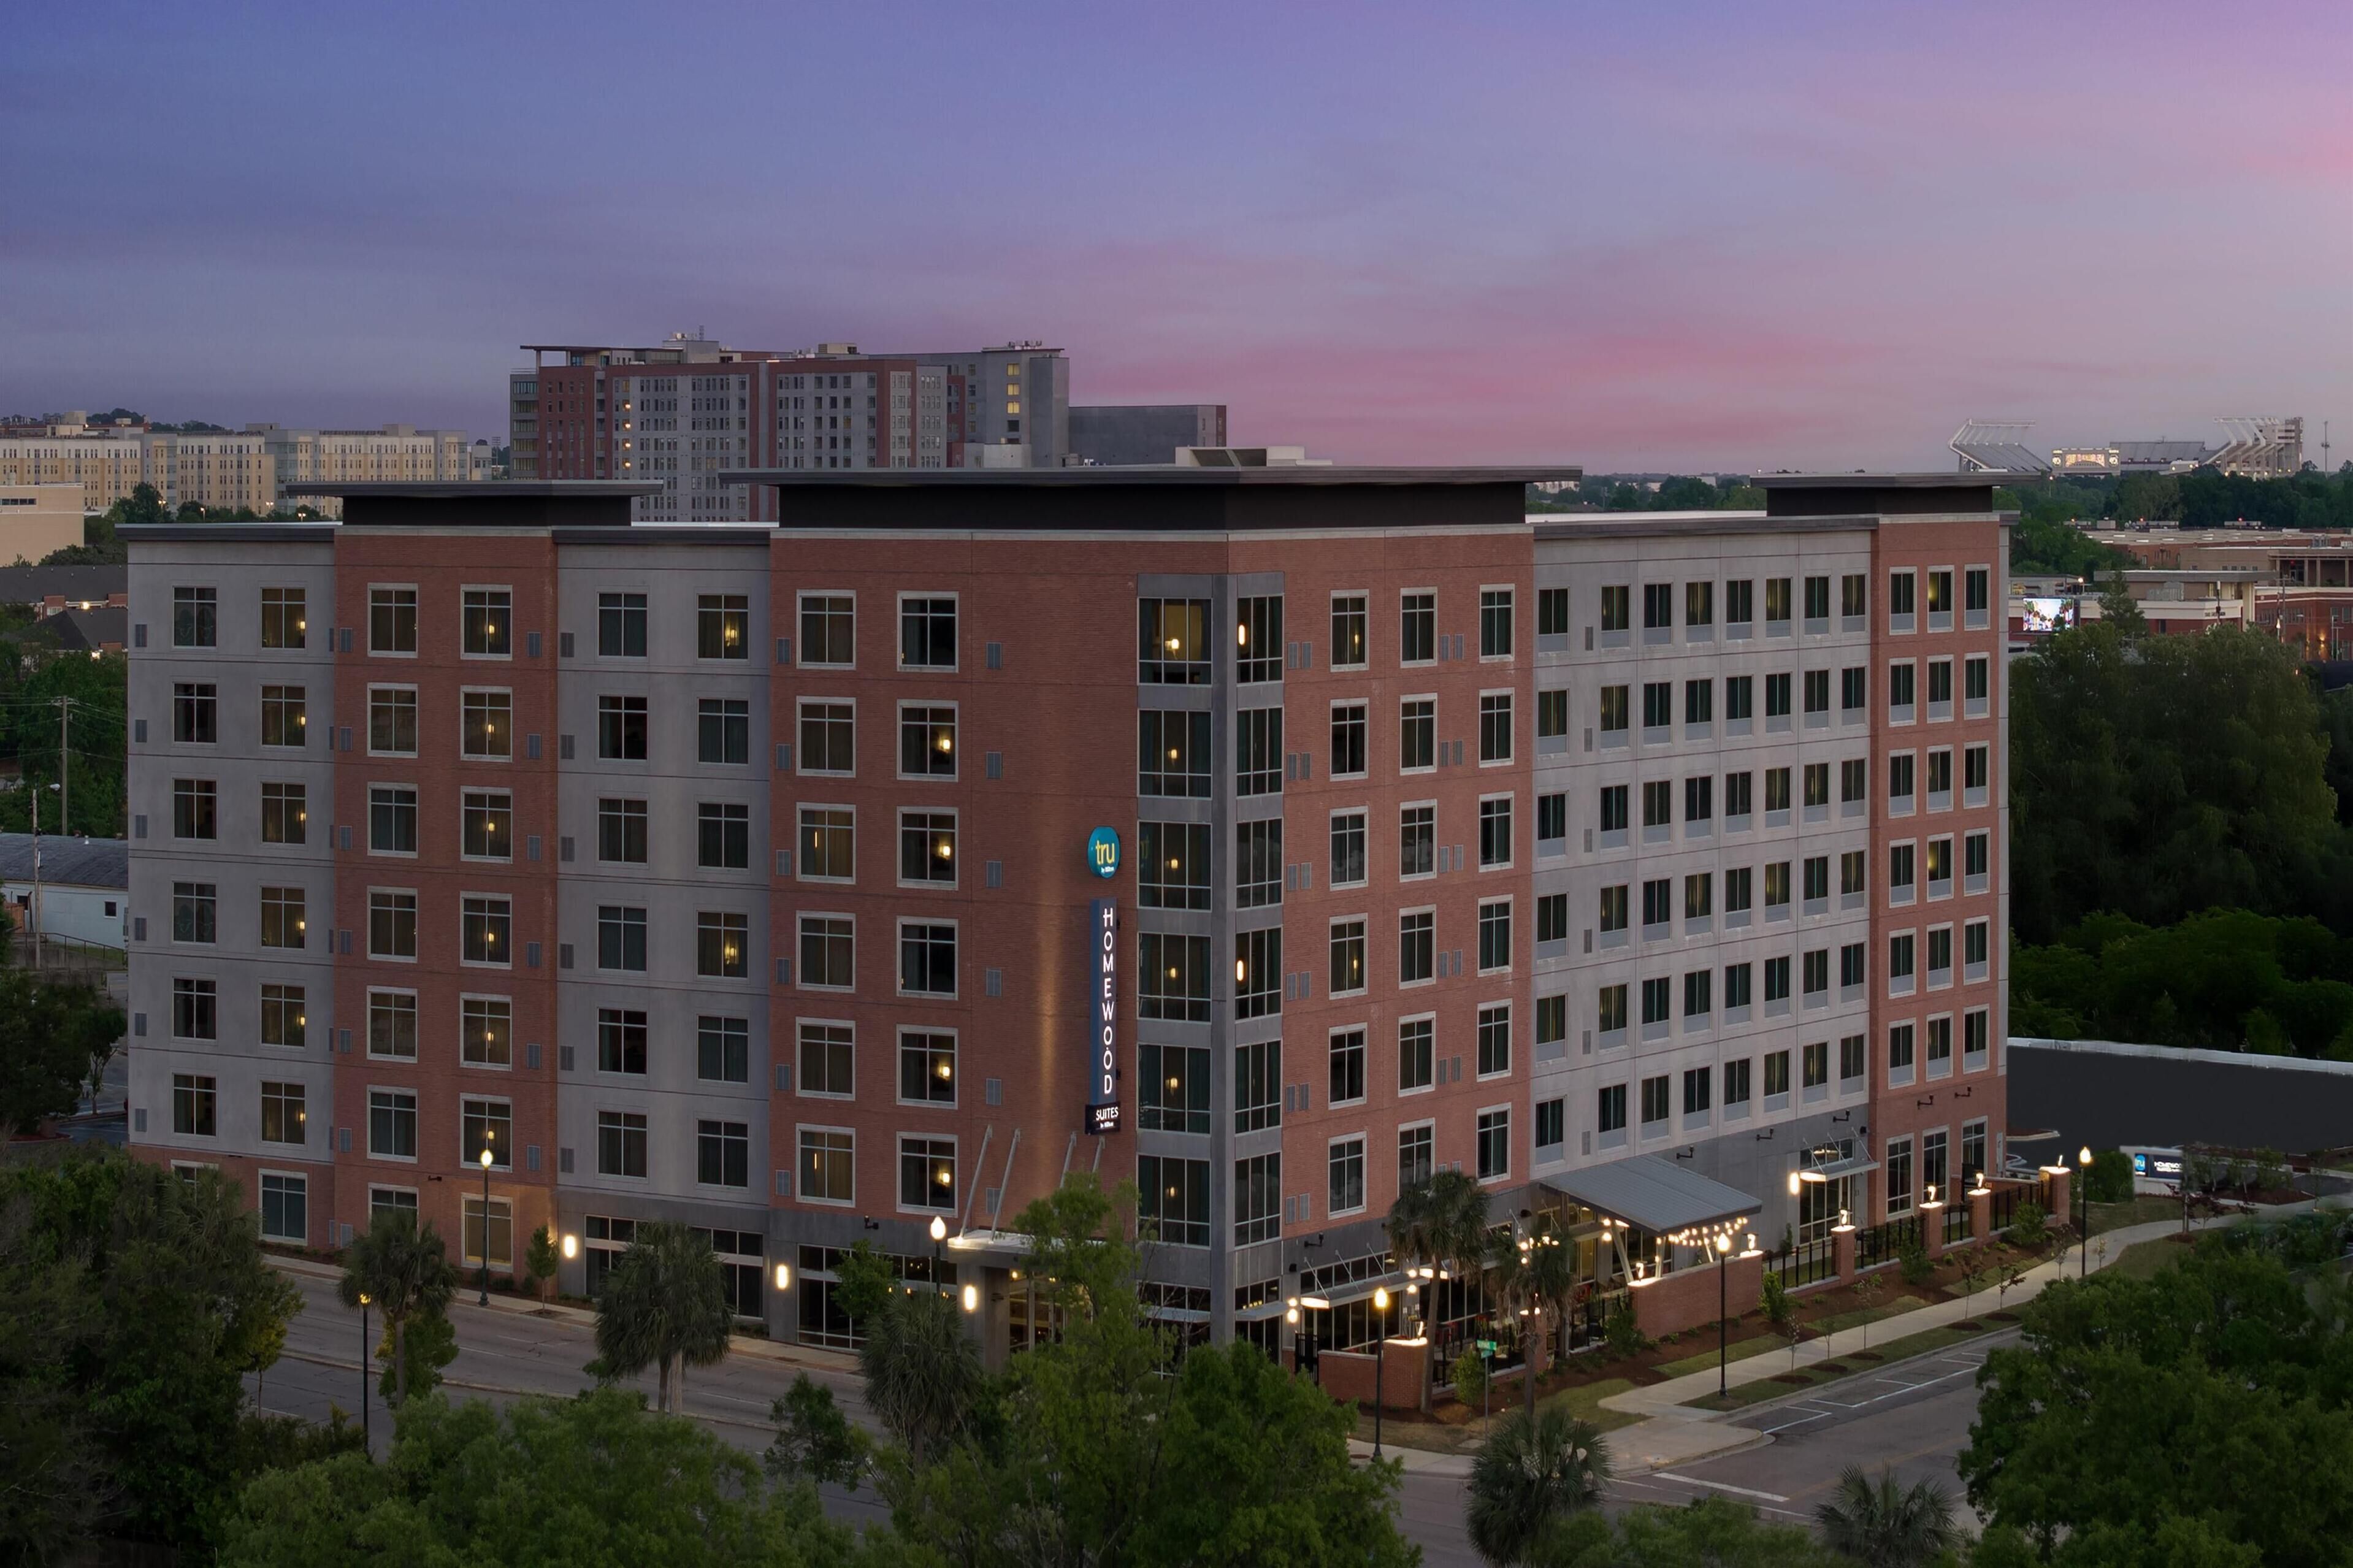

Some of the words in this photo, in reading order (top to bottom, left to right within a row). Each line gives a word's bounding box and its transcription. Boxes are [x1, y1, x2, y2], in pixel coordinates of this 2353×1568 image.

[1095, 839, 1114, 865] tru
[1102, 907, 1114, 1094] HOMEWOOD
[1095, 1106, 1119, 1121] SUITES
